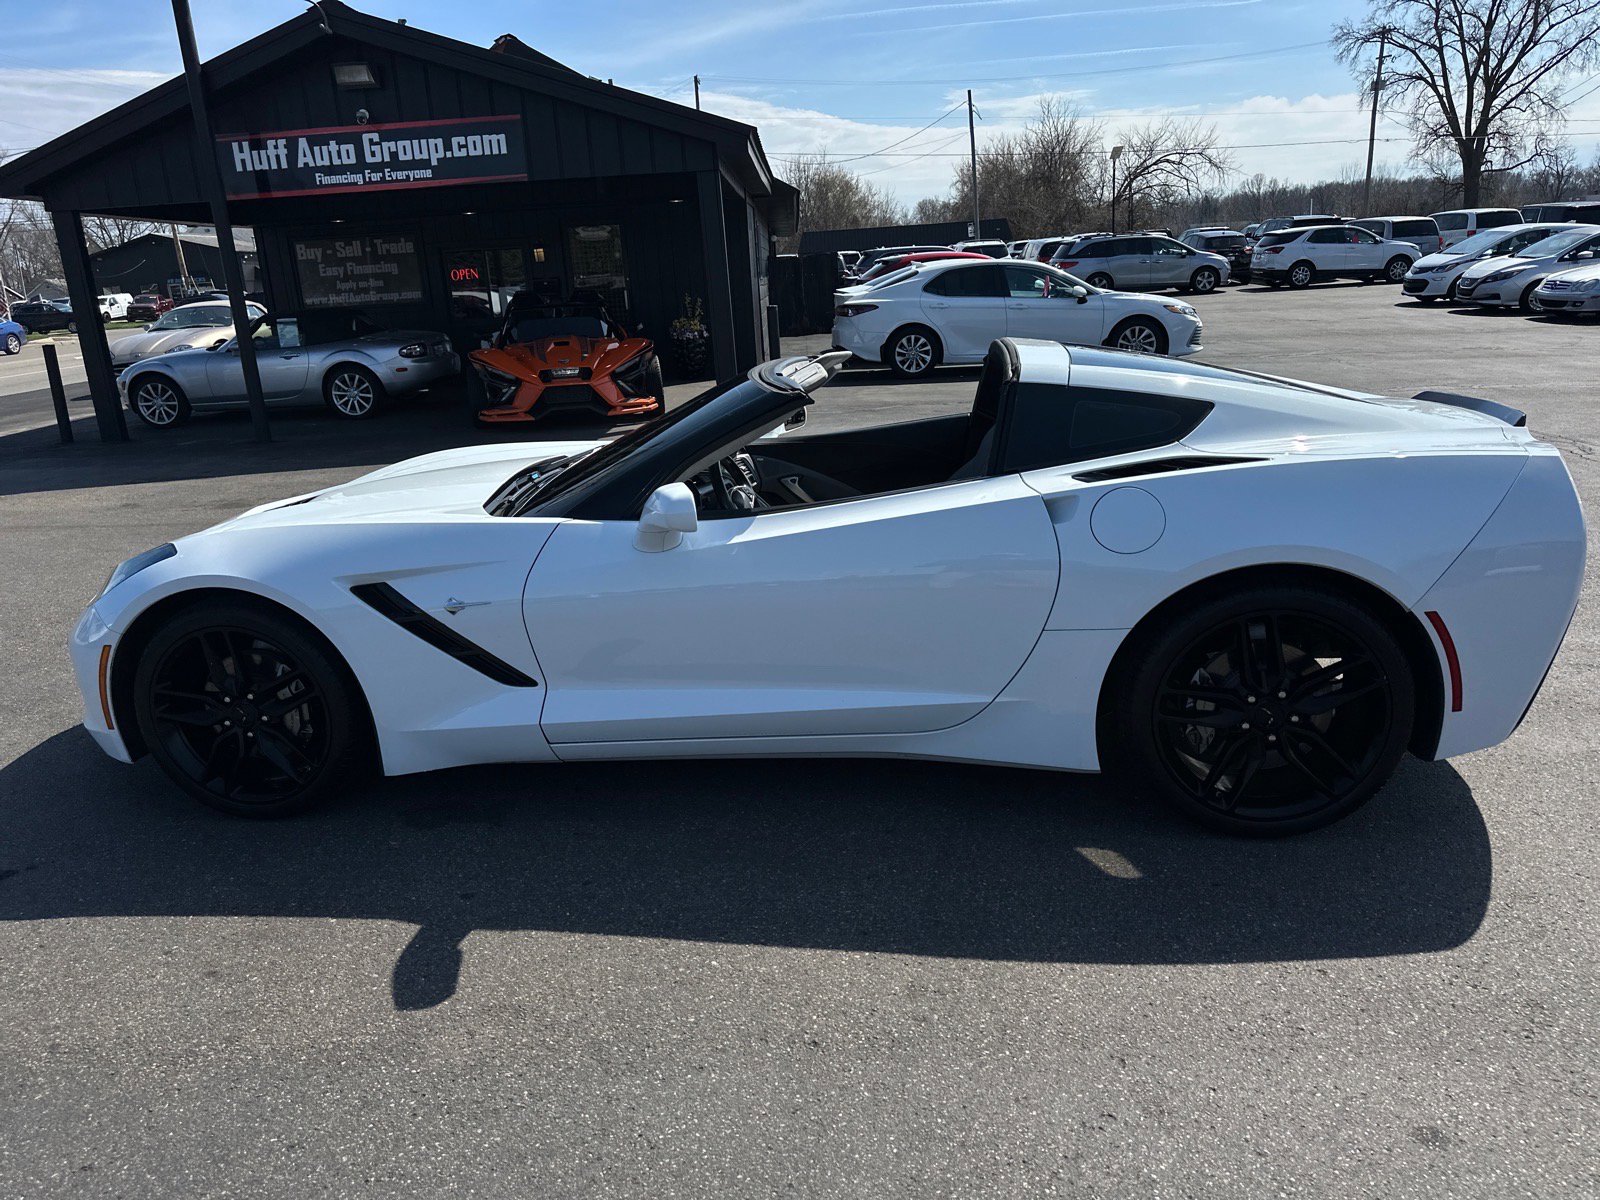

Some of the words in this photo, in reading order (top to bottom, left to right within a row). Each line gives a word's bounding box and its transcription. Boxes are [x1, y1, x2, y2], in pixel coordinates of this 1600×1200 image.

[231, 139, 288, 172] Huff
[297, 137, 357, 168] Auto
[361, 132, 508, 166] Group.com
[315, 171, 364, 185] Financing
[364, 170, 383, 183] For
[385, 168, 433, 181] Everyone
[295, 243, 323, 263] Buy
[335, 240, 363, 258] Sell
[373, 237, 414, 255] Trade
[319, 263, 344, 278] Easy
[346, 261, 399, 275] Financing
[451, 268, 479, 281] OPEN
[336, 280, 357, 290] Apply
